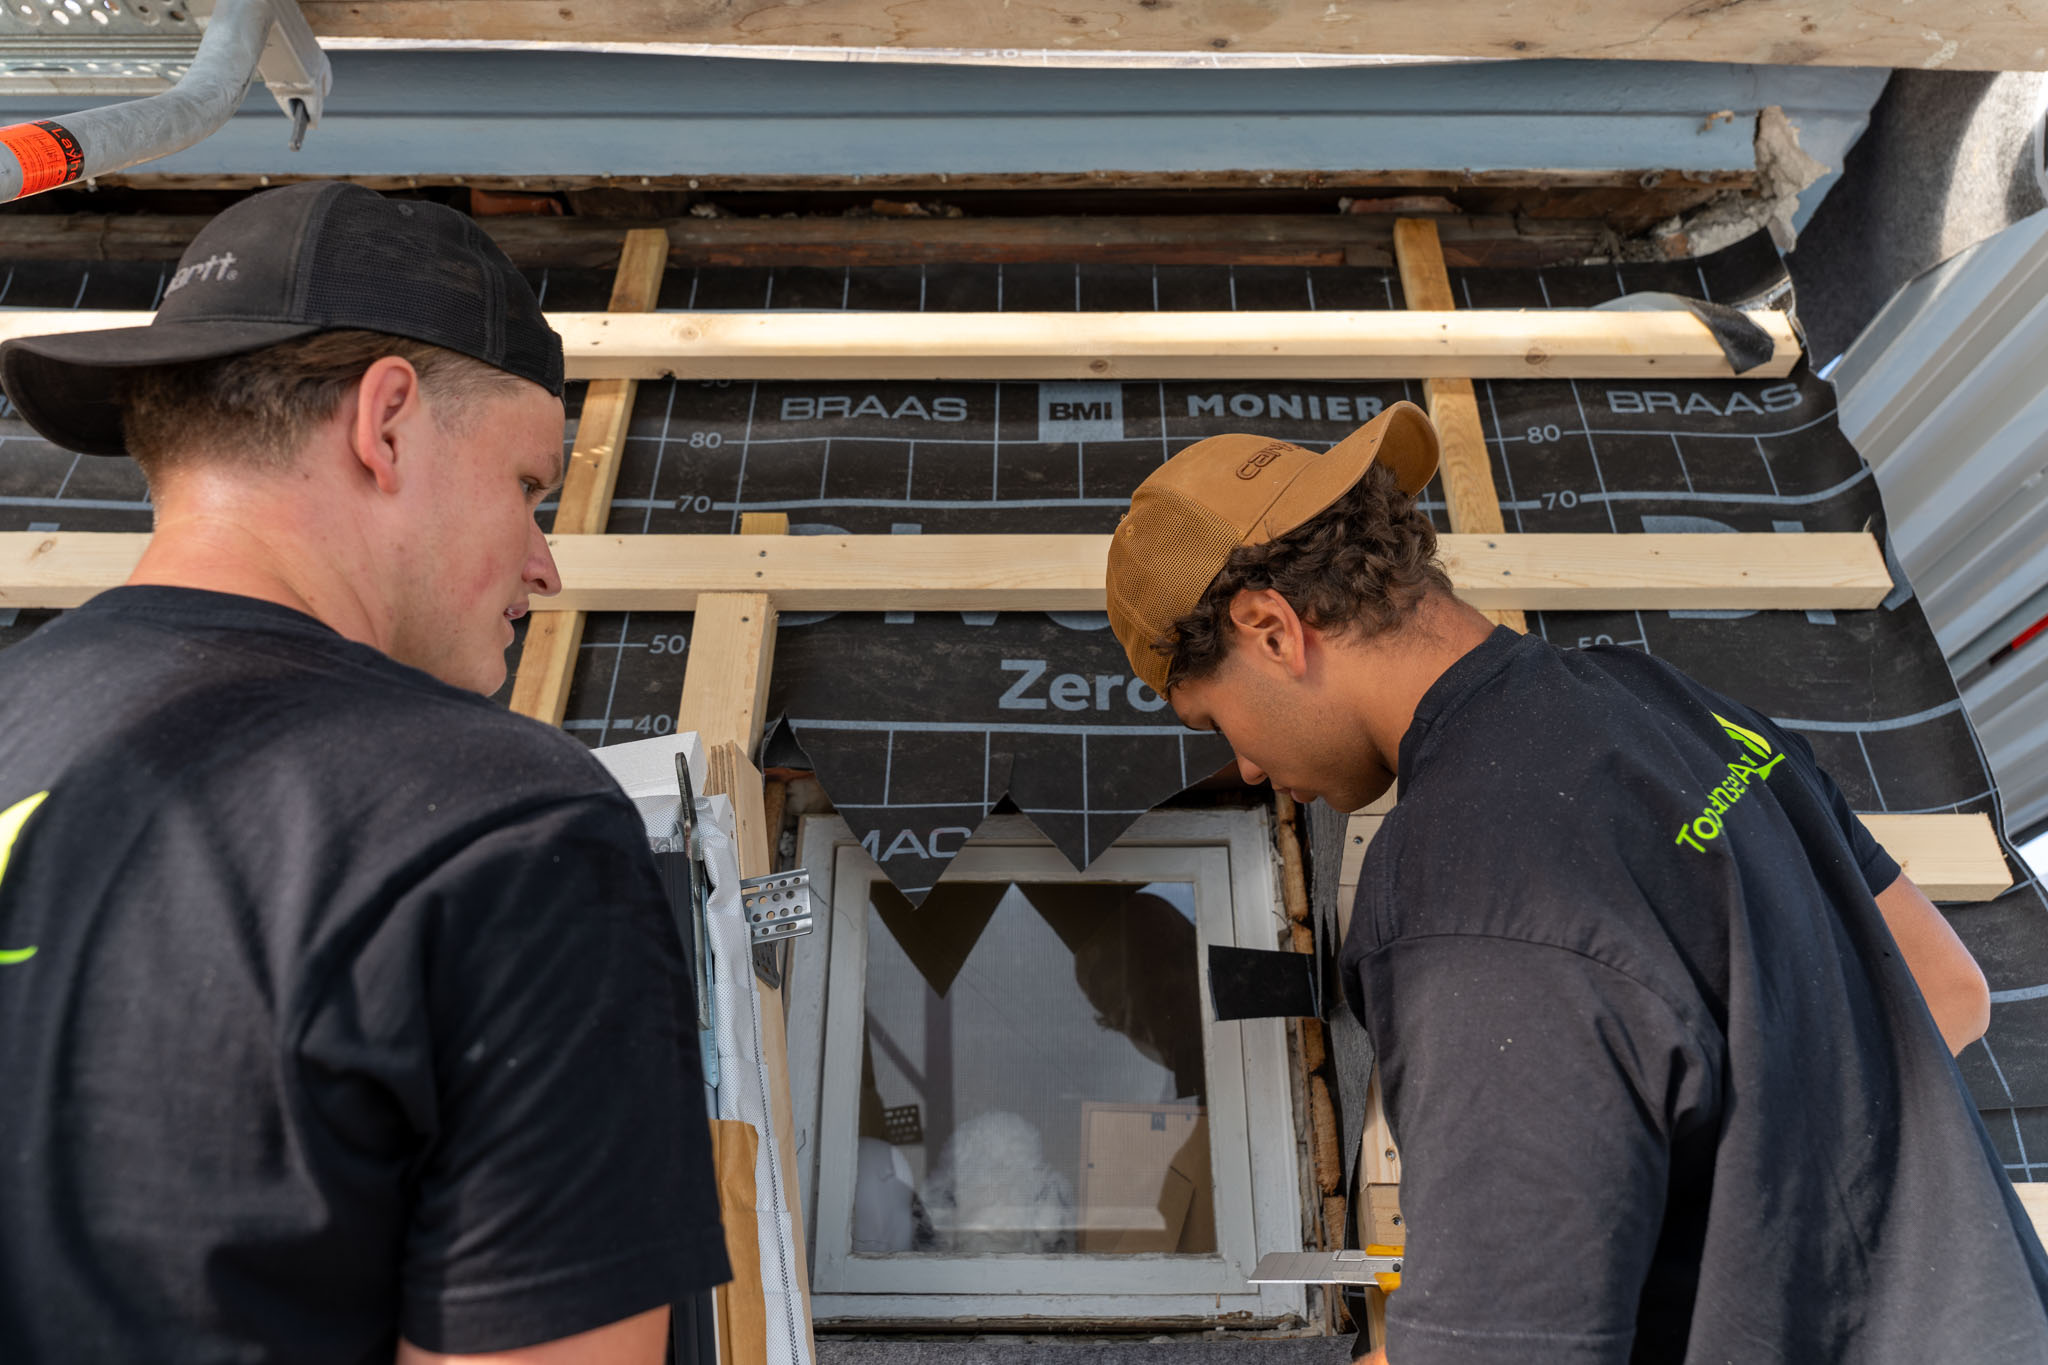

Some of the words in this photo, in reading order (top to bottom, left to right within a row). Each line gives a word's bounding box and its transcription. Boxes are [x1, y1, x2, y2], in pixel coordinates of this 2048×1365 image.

[780, 395, 967, 422] BRAAS
[1050, 402, 1112, 421] BMI
[1187, 394, 1383, 421] MONIER
[1606, 383, 1802, 416] BRAAS
[689, 432, 721, 448] 80
[1527, 424, 1560, 443] 80
[679, 495, 711, 513] 70
[1541, 490, 1577, 510] 70
[649, 635, 686, 655] 50
[999, 659, 1168, 712] Zero
[634, 714, 672, 735] 40
